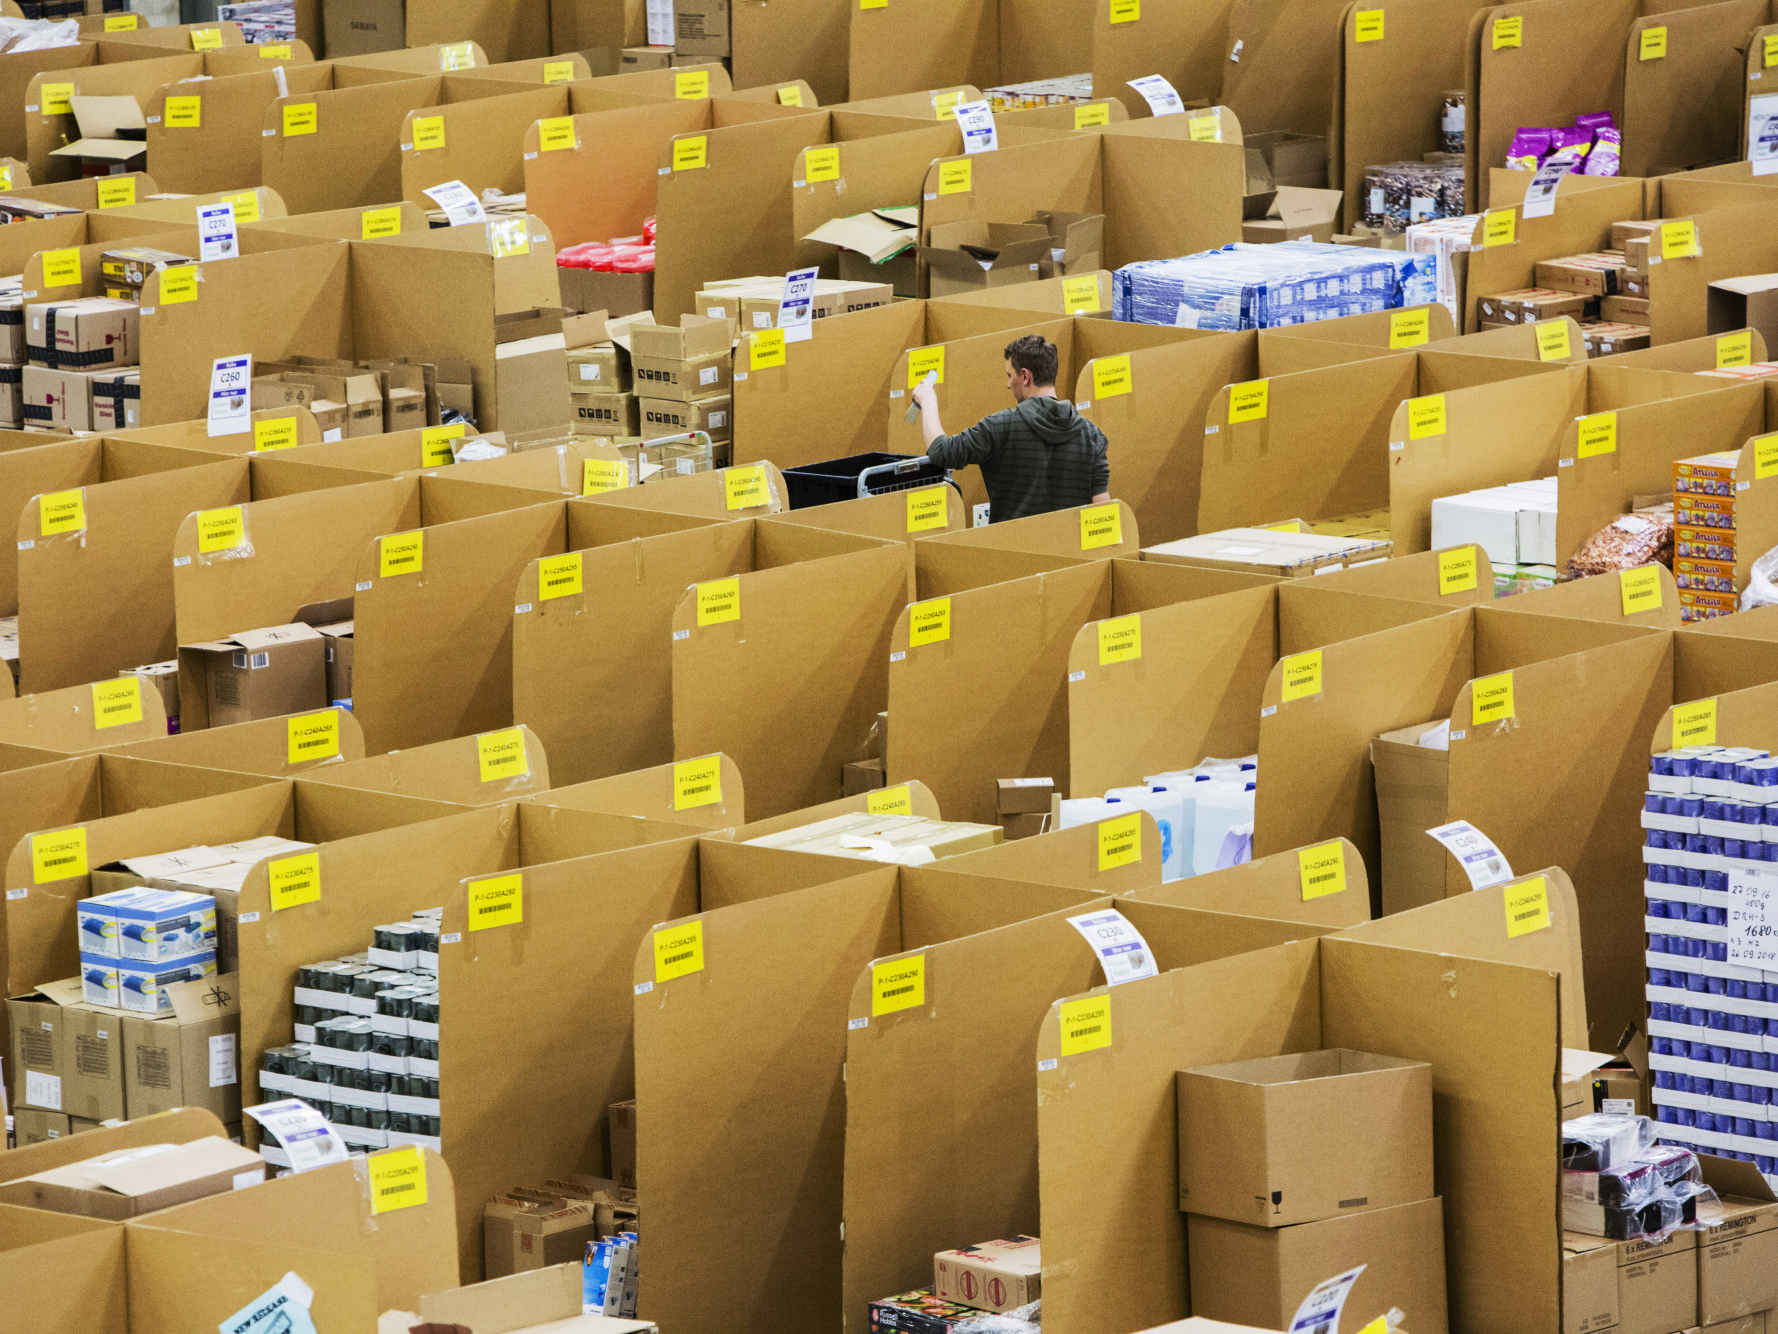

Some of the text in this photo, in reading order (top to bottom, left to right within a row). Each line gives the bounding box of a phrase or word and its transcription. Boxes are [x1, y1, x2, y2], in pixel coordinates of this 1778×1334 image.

[209, 219, 226, 229] C270
[790, 283, 808, 294] C270
[221, 372, 240, 382] C260
[260, 427, 292, 437] P-1-C260A235
[428, 436, 456, 448] P-1-C260
[544, 564, 577, 576] P-1-C250A255
[702, 592, 734, 602] P-1-C250A260
[915, 610, 945, 622] P-1-C250A265
[1104, 629, 1135, 640] P-1-C250A270
[1288, 663, 1317, 675] P-1-C250A275
[99, 690, 134, 701] P-1-C240A260
[294, 725, 332, 737] P-1-C240A265
[483, 742, 518, 754] P-1-C240A270
[680, 770, 714, 784] P-1-C240A275
[1104, 829, 1135, 843] P-1-C240A285
[39, 842, 80, 854] P-1-C230A270
[1305, 858, 1338, 871] P-1-C240A290
[276, 866, 313, 880] P-1-C230A275
[475, 888, 515, 901] P-1-C230A280
[1096, 926, 1123, 938] C230
[1744, 925, 1772, 937] 1680
[660, 935, 696, 950] P-1-C230A285
[878, 970, 918, 984] P-1-C230A290
[1066, 1010, 1104, 1024] P-1-C230A295
[1720, 1215, 1757, 1232] REMINGTON
[1626, 1246, 1630, 1254] 6
[234, 1295, 288, 1334] NEW RELEASE
